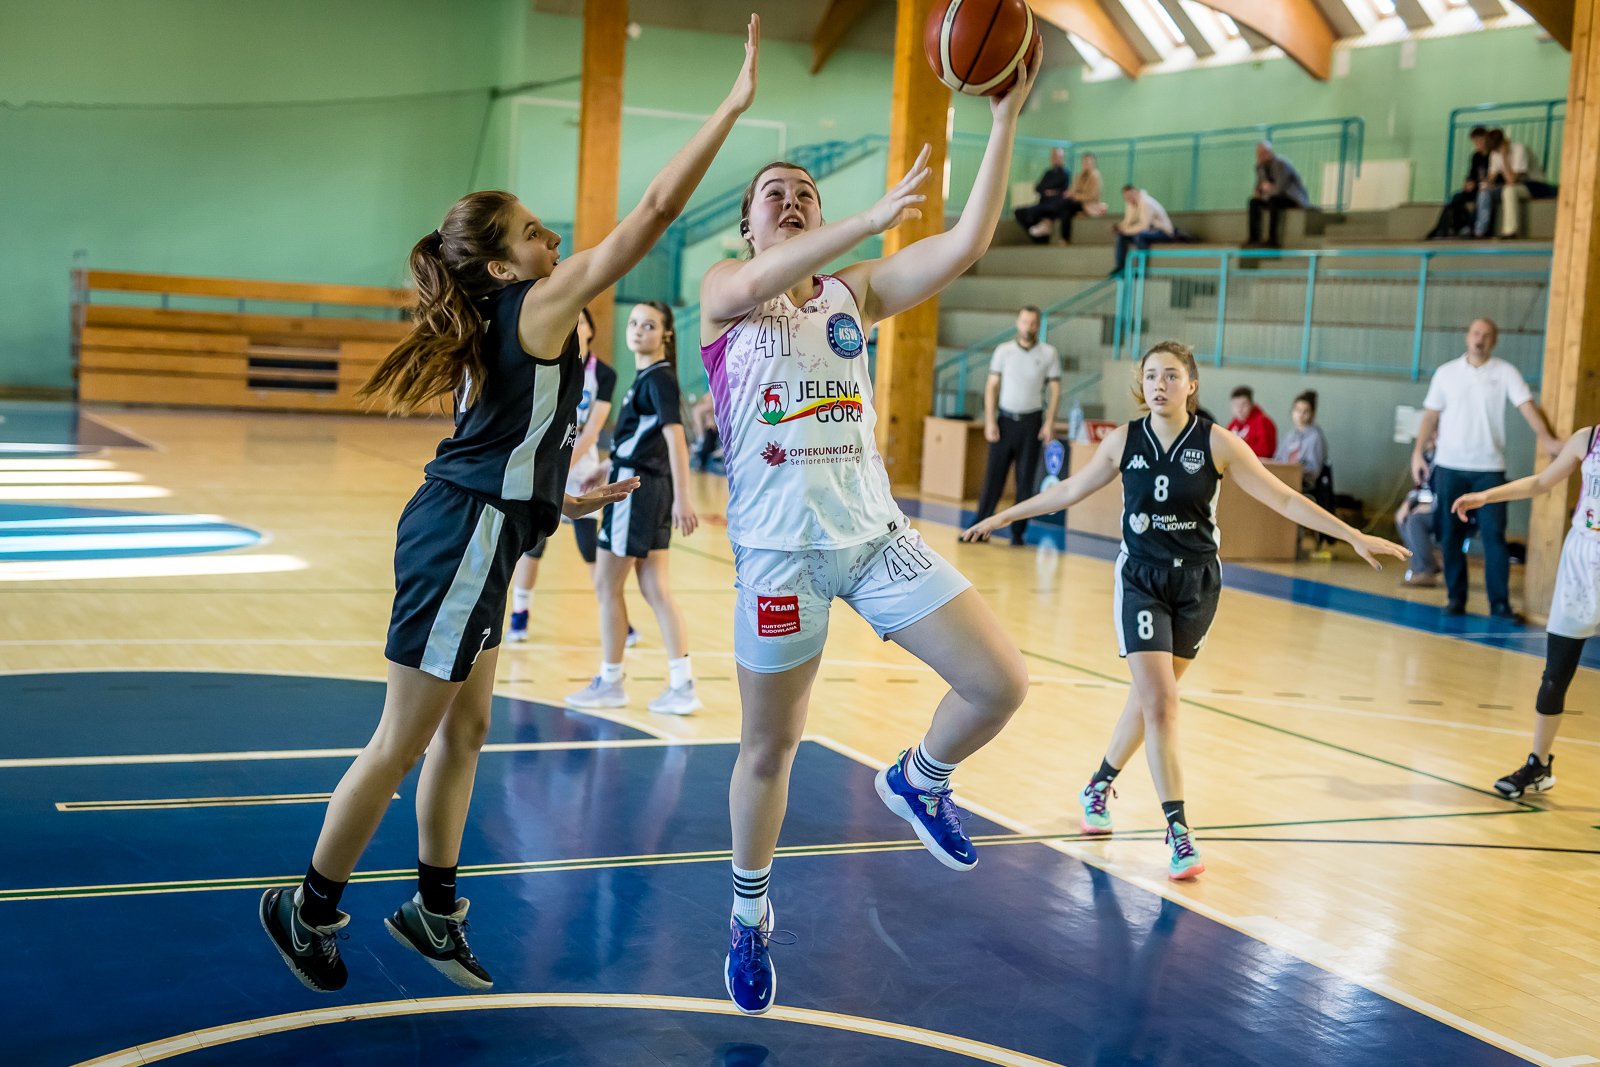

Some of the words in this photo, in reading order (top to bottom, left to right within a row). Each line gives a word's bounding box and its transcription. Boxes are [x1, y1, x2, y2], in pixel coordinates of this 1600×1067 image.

[755, 315, 791, 358] 41
[795, 380, 862, 403] JELENIA
[815, 400, 863, 423] GÓRA
[1154, 474, 1170, 502] 8
[1151, 513, 1178, 523] GMINA
[1152, 521, 1197, 532] POLKOWICE
[882, 534, 933, 581] 41
[761, 621, 797, 629] HURTOWNIA
[1136, 609, 1154, 641] 8
